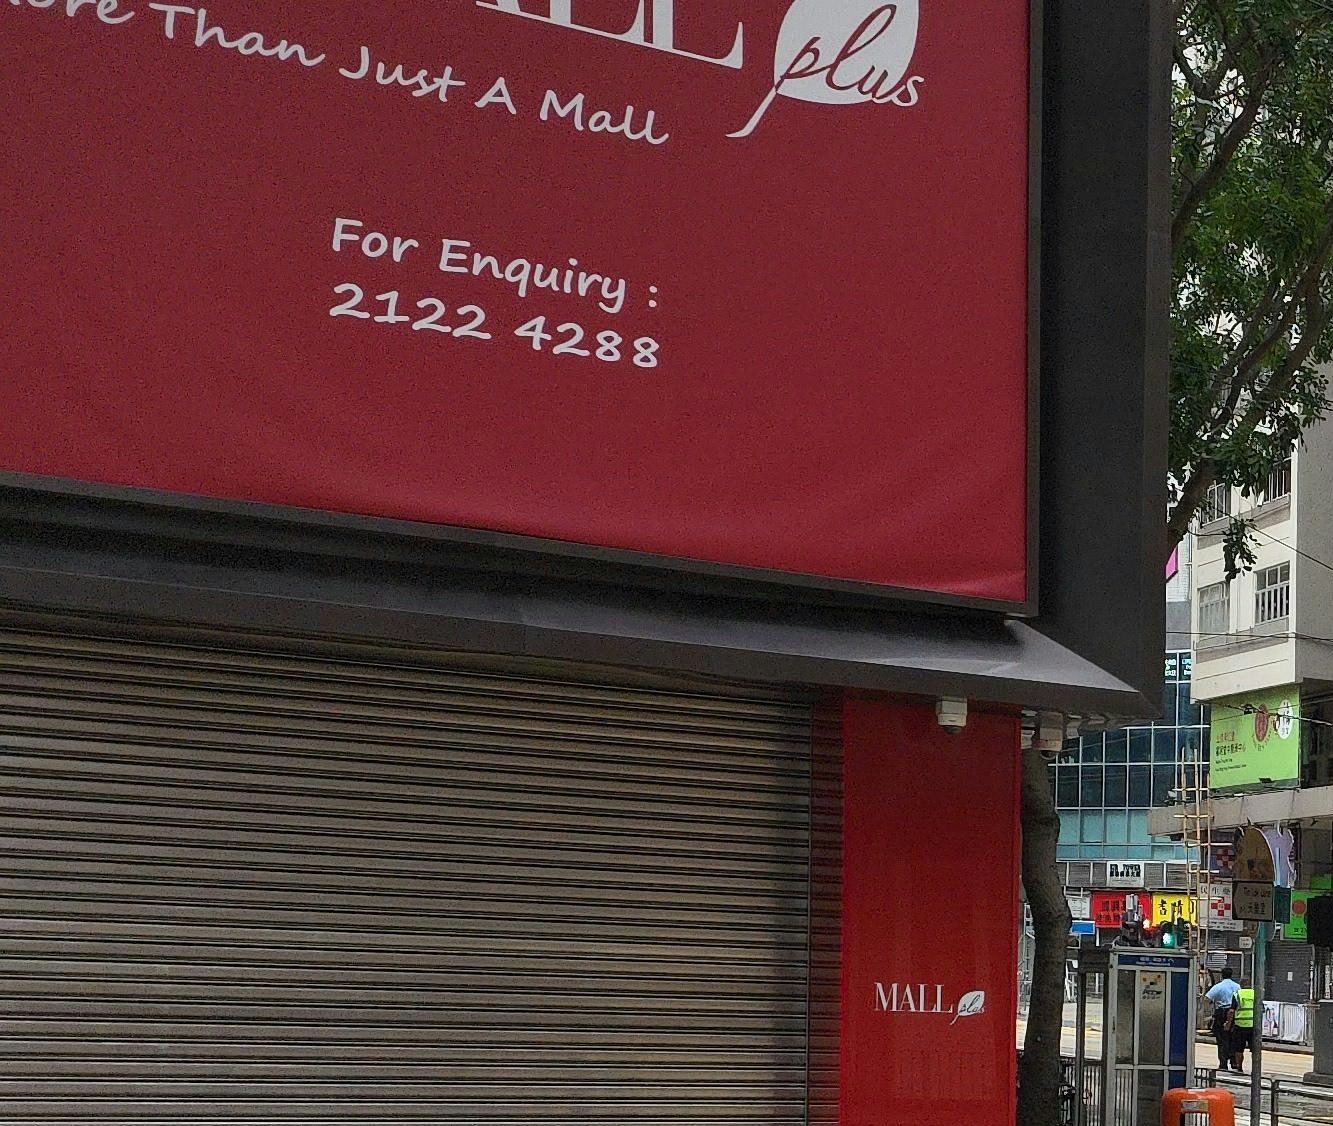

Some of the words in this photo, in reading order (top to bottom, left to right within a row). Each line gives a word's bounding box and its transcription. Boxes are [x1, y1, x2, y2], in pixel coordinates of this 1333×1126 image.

[149, 3, 326, 67] Than
[339, 46, 466, 102] Just
[474, 77, 517, 115] A
[539, 90, 669, 145] Mall
[725, 3, 925, 138] plus
[332, 217, 420, 263] For
[439, 237, 630, 313] Enquiry
[328, 283, 493, 342] 2122
[514, 316, 661, 369] 4288
[874, 982, 953, 1013] MALL
